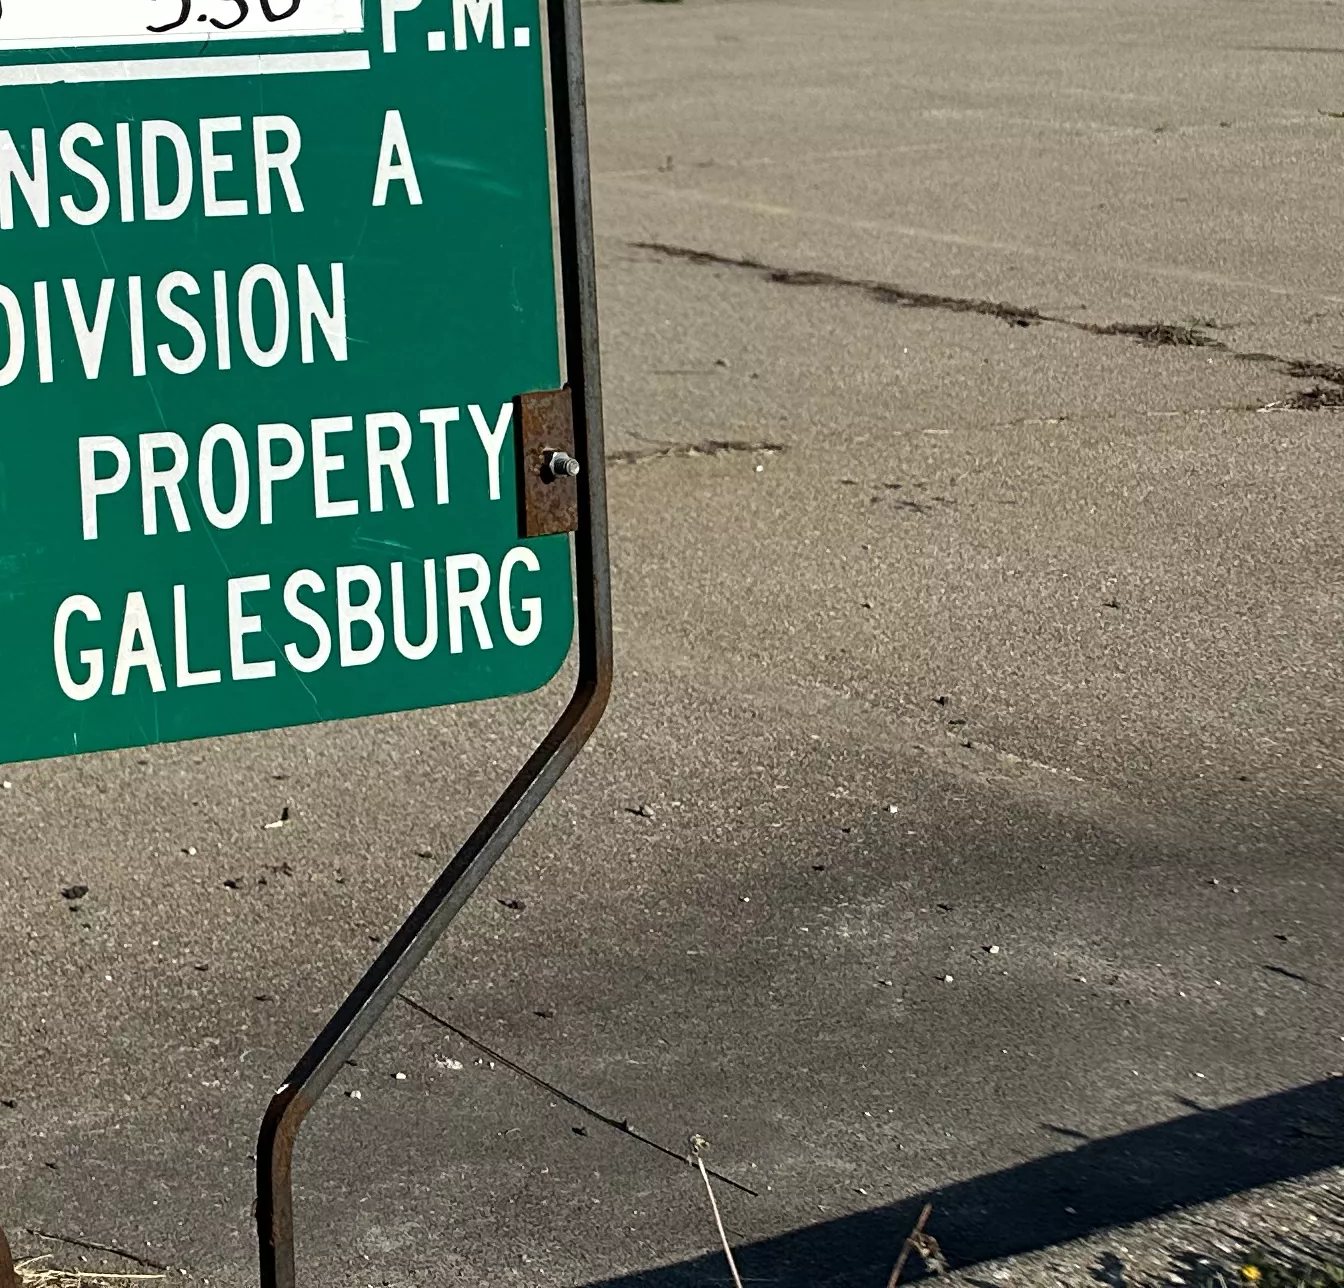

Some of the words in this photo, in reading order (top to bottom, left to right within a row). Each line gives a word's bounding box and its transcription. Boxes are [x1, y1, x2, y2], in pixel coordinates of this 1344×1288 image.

[372, 109, 423, 207] A
[78, 402, 514, 541] PROPERTY
[53, 546, 543, 701] GALESBURG
